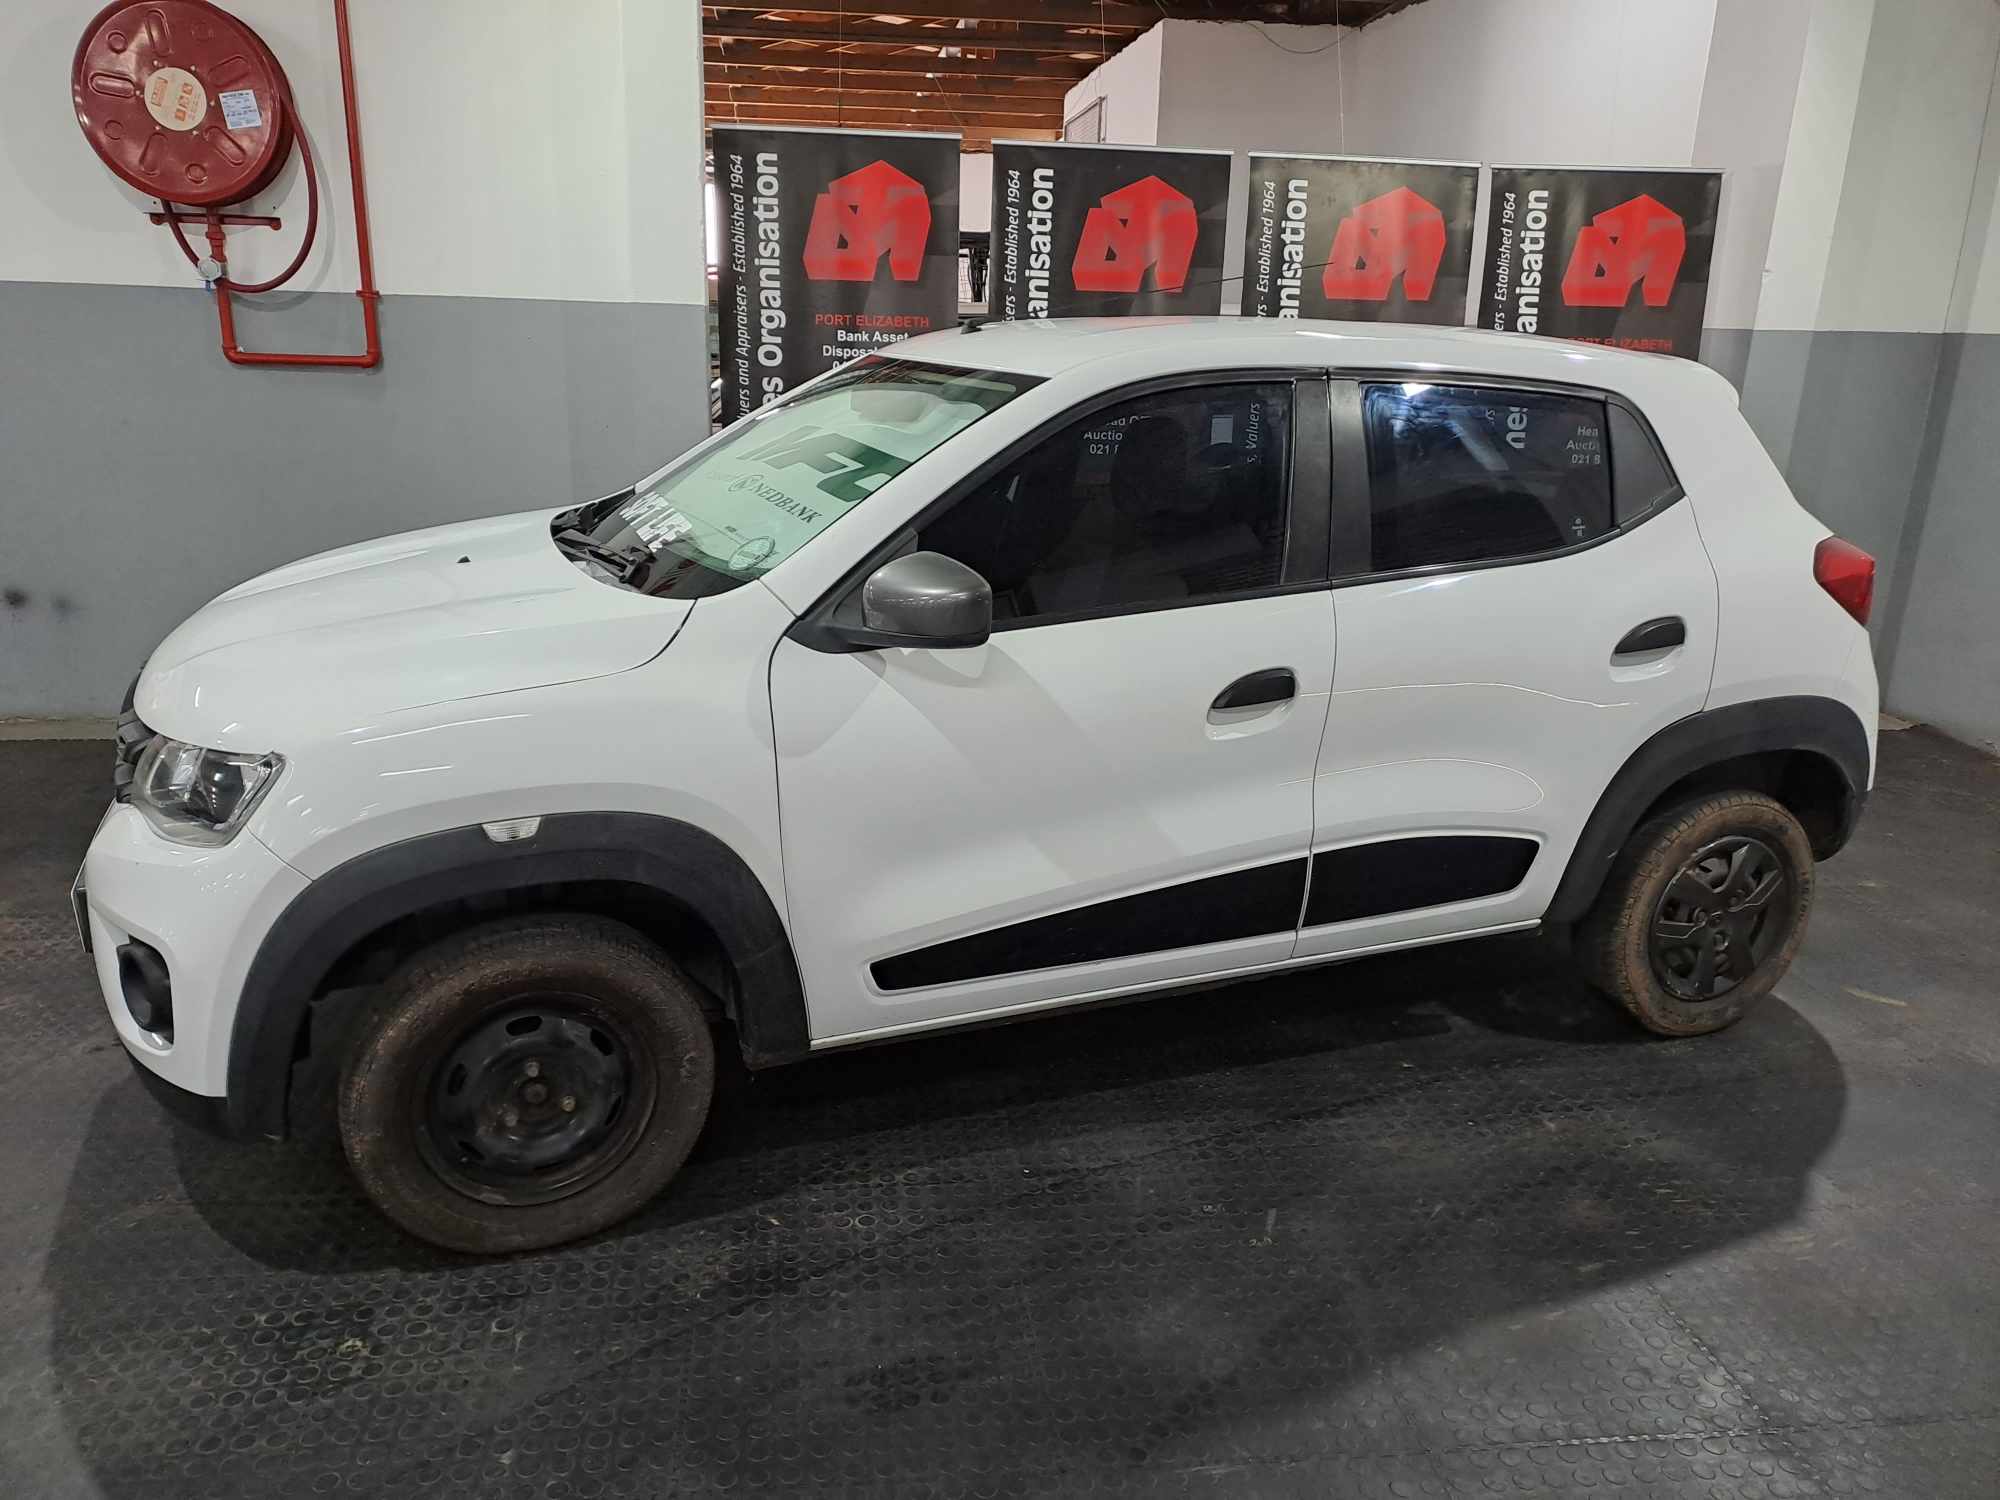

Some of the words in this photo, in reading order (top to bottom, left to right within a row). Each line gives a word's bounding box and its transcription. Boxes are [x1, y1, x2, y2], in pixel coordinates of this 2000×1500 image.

[730, 154, 744, 189] 1964
[1007, 169, 1021, 205] 1964
[1263, 180, 1277, 214] 1964
[1503, 192, 1517, 224] 1964
[730, 192, 746, 272] Established
[1004, 205, 1020, 284] Established
[1025, 168, 1055, 318] anisation
[1277, 178, 1309, 320] anisation
[1256, 216, 1274, 293] Established
[1494, 227, 1513, 302] Established
[1515, 189, 1549, 333] anisation
[733, 284, 752, 356] Appraisers
[815, 314, 852, 326] PORT
[856, 315, 929, 328] ELIZABETH
[1002, 294, 1016, 322] sers
[1494, 311, 1505, 331] ers
[837, 330, 869, 342] Bank
[873, 331, 909, 342] Asset
[735, 358, 750, 385] and
[1245, 402, 1261, 449] Valuers
[1089, 444, 1110, 455] 021
[753, 482, 823, 523] NEDBANK
